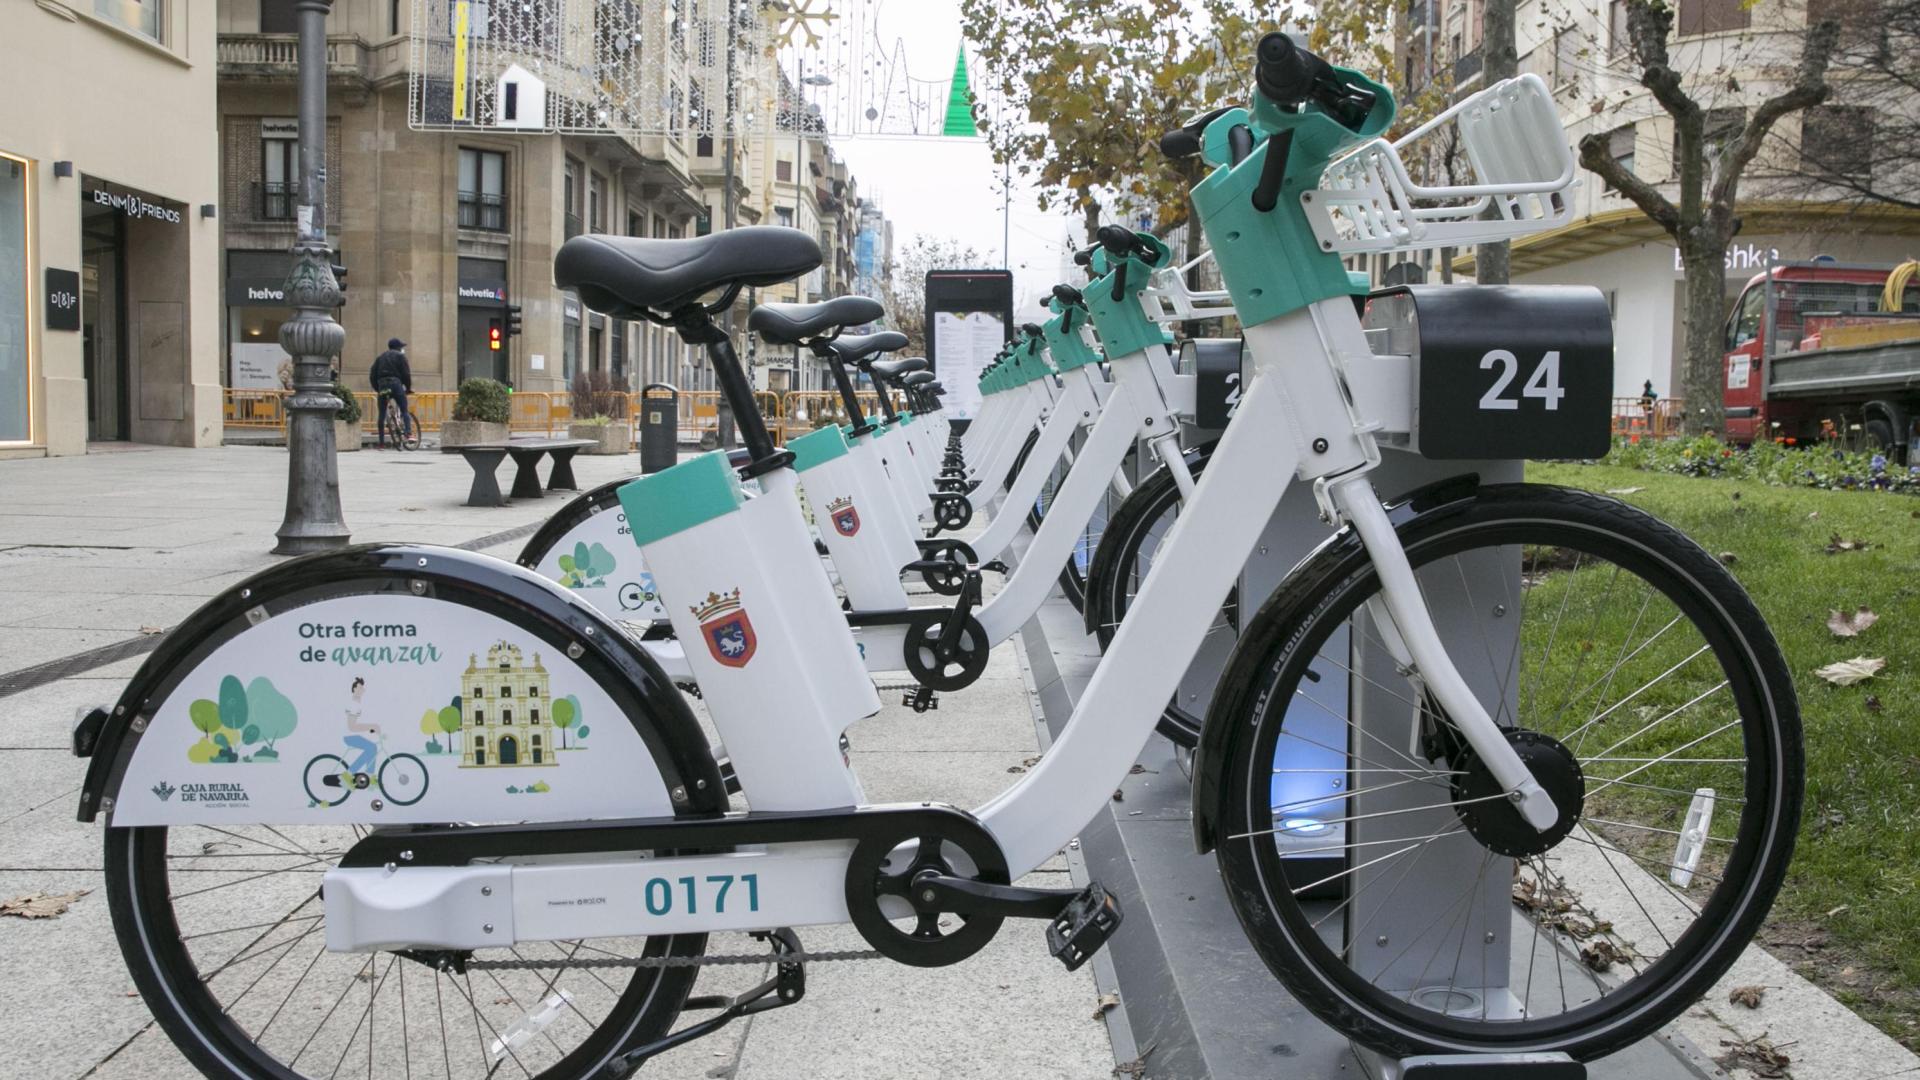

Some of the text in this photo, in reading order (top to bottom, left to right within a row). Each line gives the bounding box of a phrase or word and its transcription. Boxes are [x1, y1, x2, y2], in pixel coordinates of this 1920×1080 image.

[248, 288, 284, 299] helve
[459, 287, 495, 298] helvetia
[1225, 372, 1240, 404] 2
[1479, 349, 1565, 410] 24
[299, 621, 417, 638] Otra forma
[300, 642, 443, 666] de avanzar
[1251, 690, 1267, 726] CST
[181, 783, 244, 793] CAJA RURAL
[182, 792, 249, 801] DE NAVARRA
[645, 874, 759, 916] 0171
